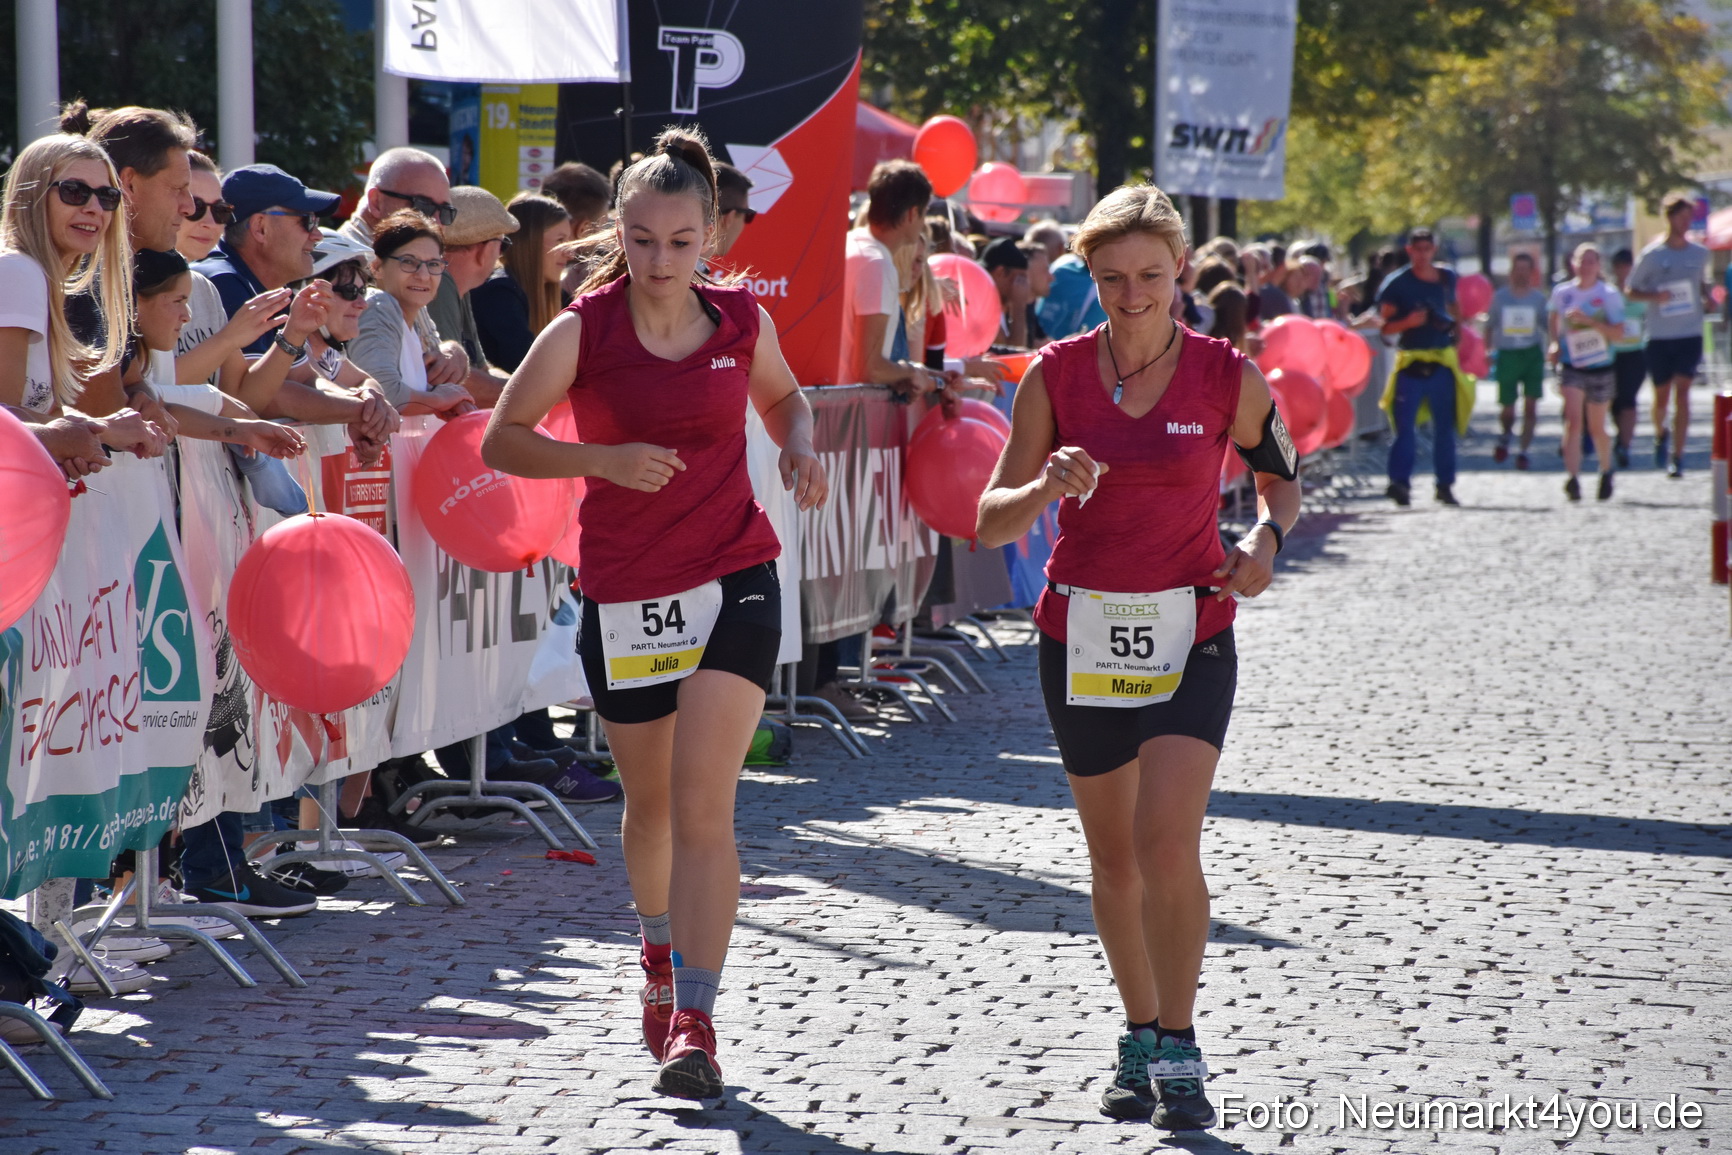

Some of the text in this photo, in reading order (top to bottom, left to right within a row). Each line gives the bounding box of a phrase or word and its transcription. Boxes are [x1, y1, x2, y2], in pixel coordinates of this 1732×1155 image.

[664, 34, 690, 44] Team
[710, 355, 737, 370] Julia
[1166, 421, 1204, 435] Maria
[1103, 602, 1160, 617] BOCK
[641, 599, 686, 637] 54
[631, 638, 689, 652] PARTL Neumarkt
[1110, 625, 1155, 660] 55
[650, 656, 680, 674] Julia
[1096, 661, 1161, 672] PARTL Neumarkt
[1111, 678, 1153, 695] Maria
[169, 710, 199, 728] GmbH
